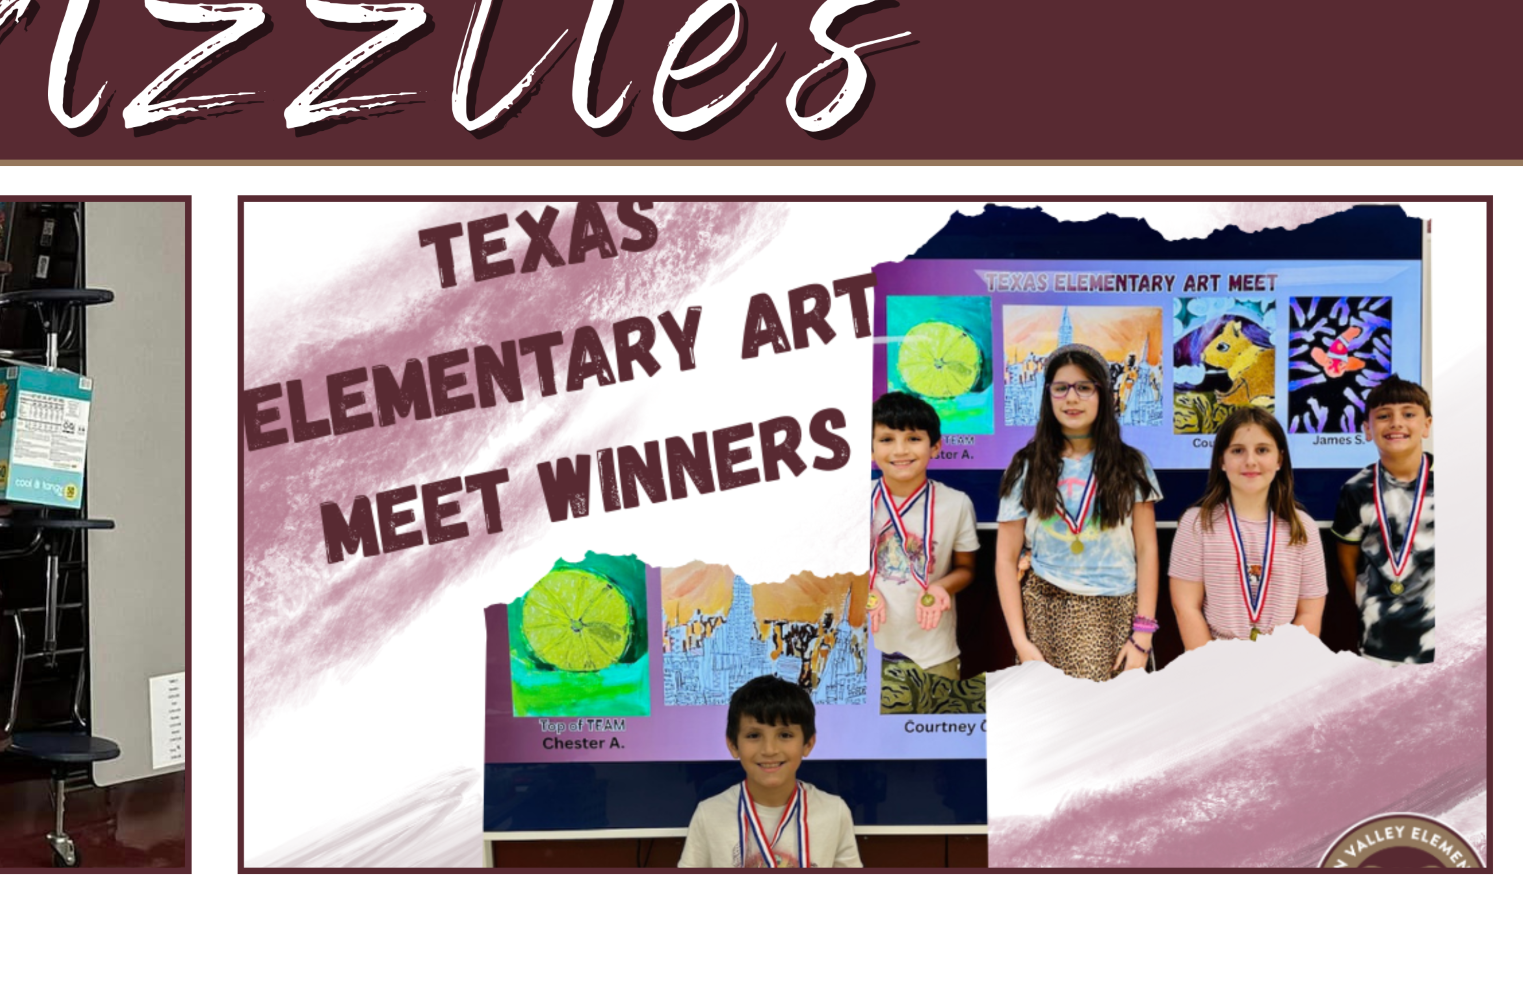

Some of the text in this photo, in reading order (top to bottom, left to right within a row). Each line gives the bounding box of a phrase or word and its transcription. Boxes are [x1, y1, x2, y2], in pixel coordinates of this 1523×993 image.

[984, 272, 1279, 293] TEXAS ELEMENTARY ART MEET
[943, 435, 976, 445] TEAM
[1312, 434, 1366, 445] James S.
[961, 449, 974, 460] A.
[15, 479, 33, 489] cool
[538, 718, 627, 735] Top of TEAM
[904, 719, 976, 736] Courtney
[542, 737, 626, 750] Chester A.
